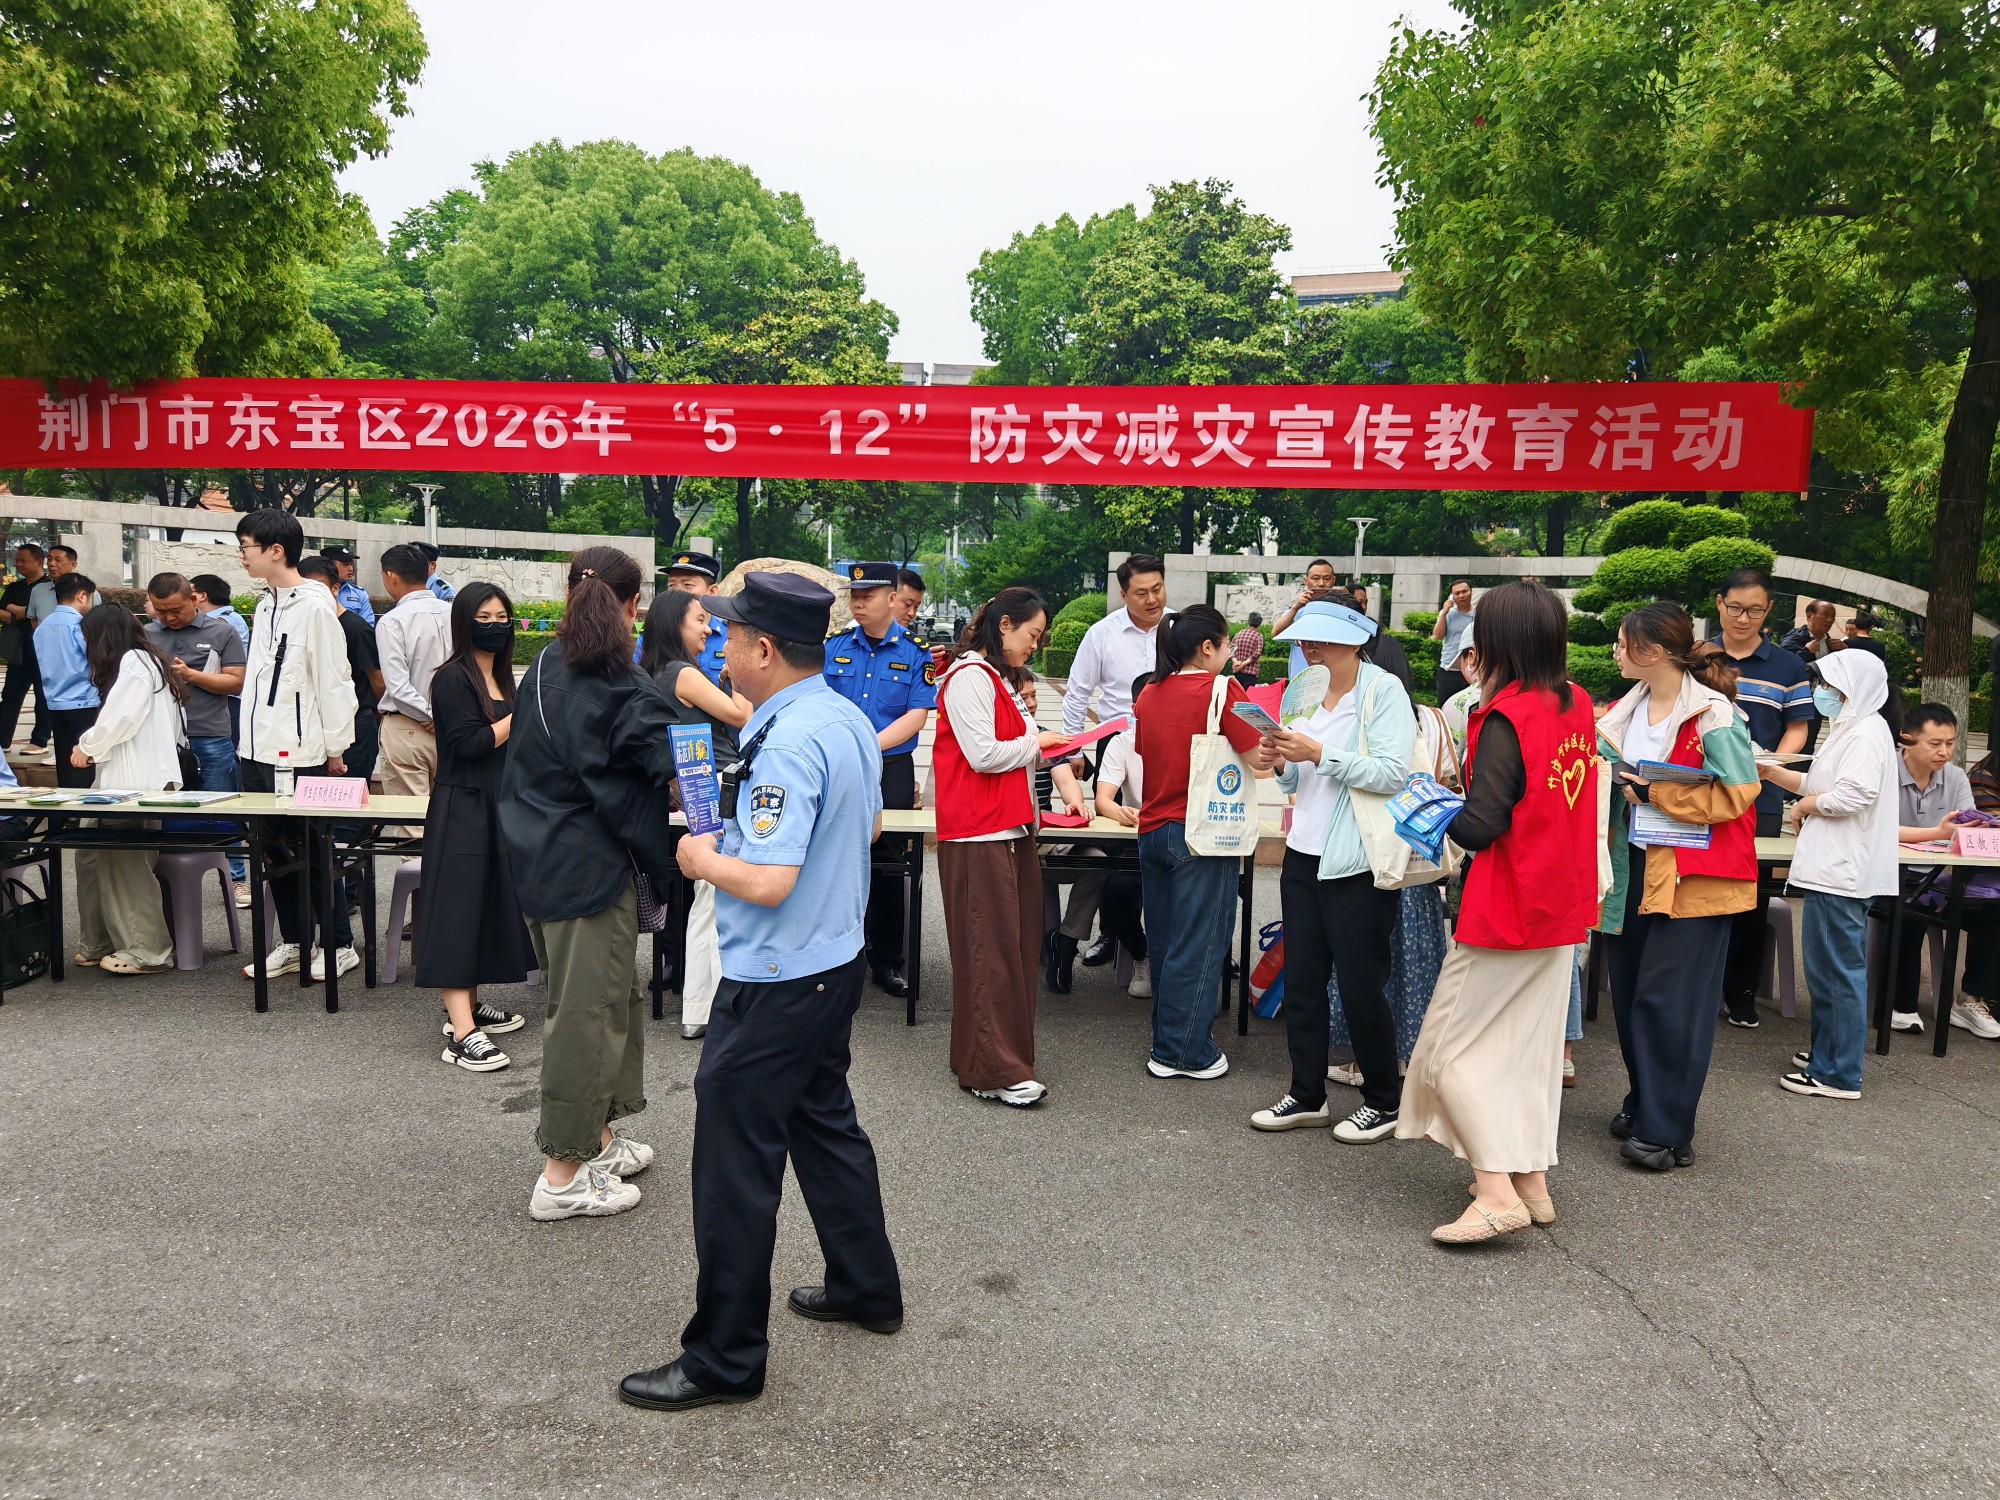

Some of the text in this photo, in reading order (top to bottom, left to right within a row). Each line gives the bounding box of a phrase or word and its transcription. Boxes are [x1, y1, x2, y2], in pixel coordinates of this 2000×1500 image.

[37, 392, 633, 457] 荆门市东宝区2026年
[970, 401, 1744, 472] 防灾减灾宣传教育活动
[1207, 801, 1245, 814] 防灾 减灾
